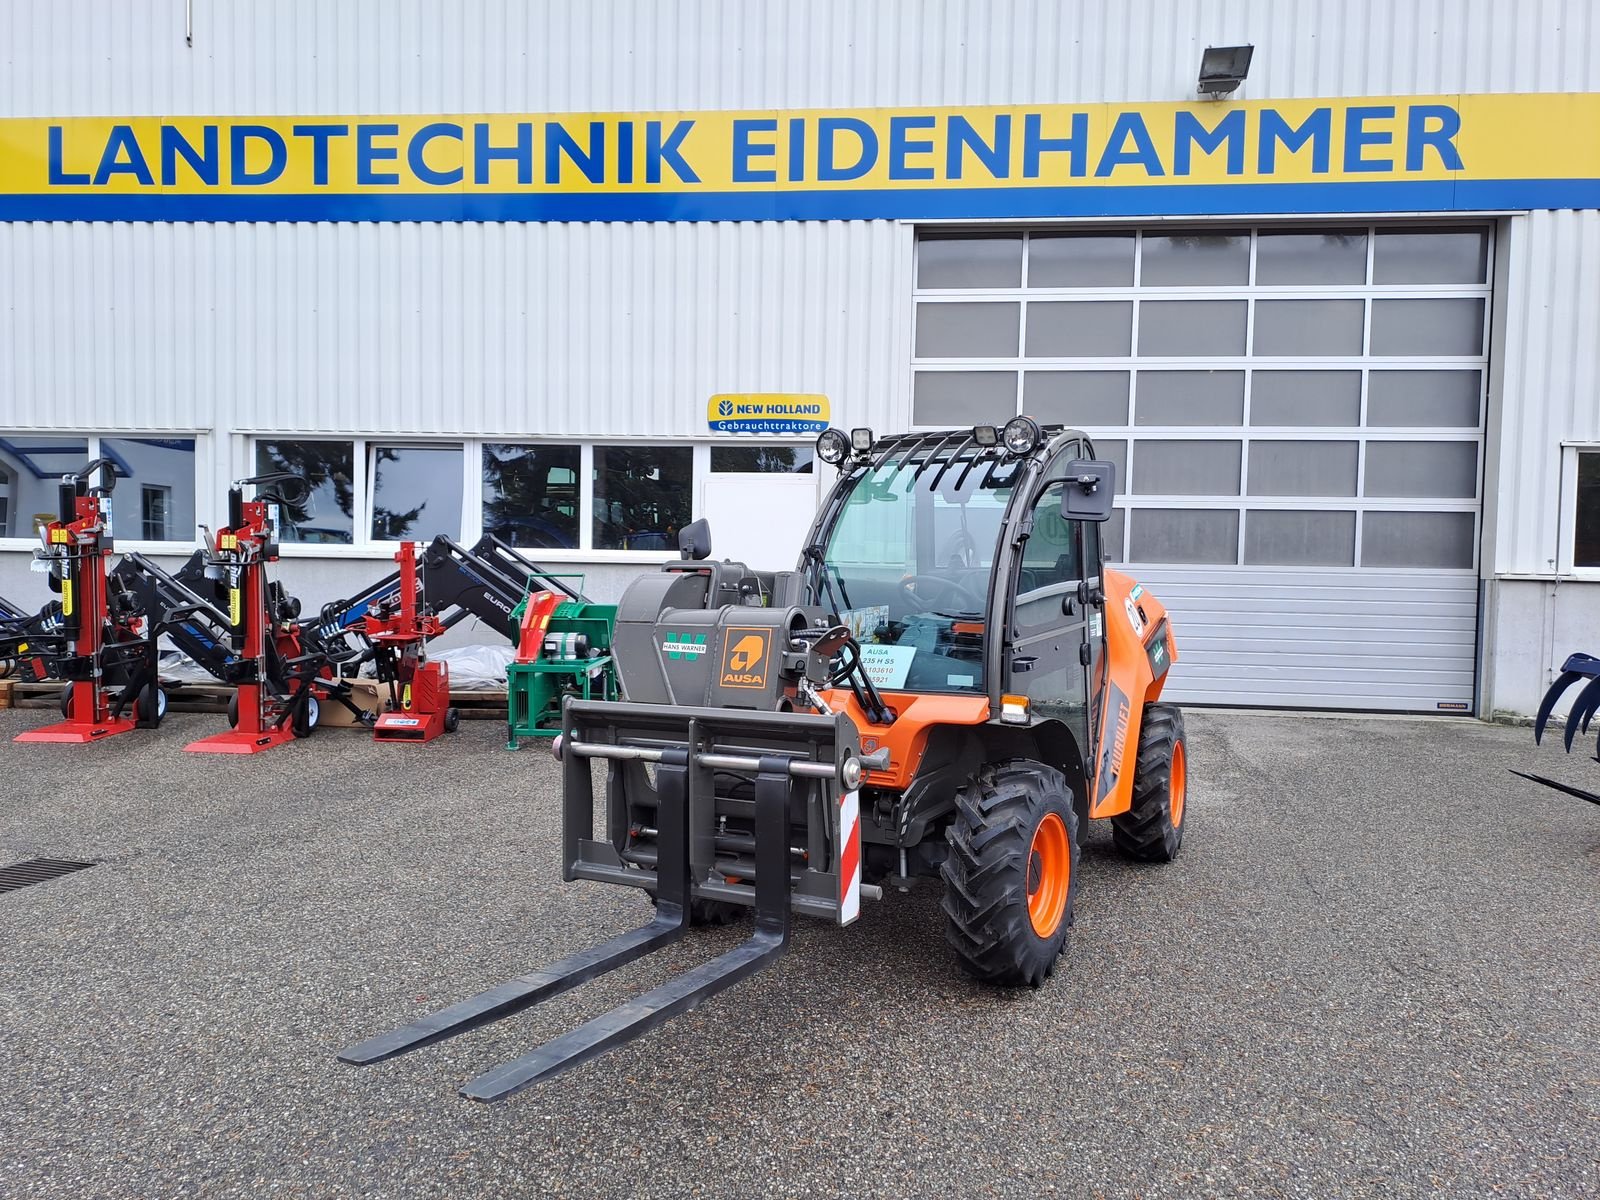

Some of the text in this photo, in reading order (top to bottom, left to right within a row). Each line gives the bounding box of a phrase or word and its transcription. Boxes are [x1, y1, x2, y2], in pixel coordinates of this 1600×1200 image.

[48, 104, 1464, 186] LANDTECHNIK EIDENHAMMER
[737, 404, 821, 415] NEW HOLLAND
[718, 420, 822, 431] Gebrauchttraktore
[483, 591, 511, 614] EURO
[680, 644, 705, 652] WARNER
[724, 674, 762, 684] AUSA
[1110, 702, 1129, 776] TAURULIFT
